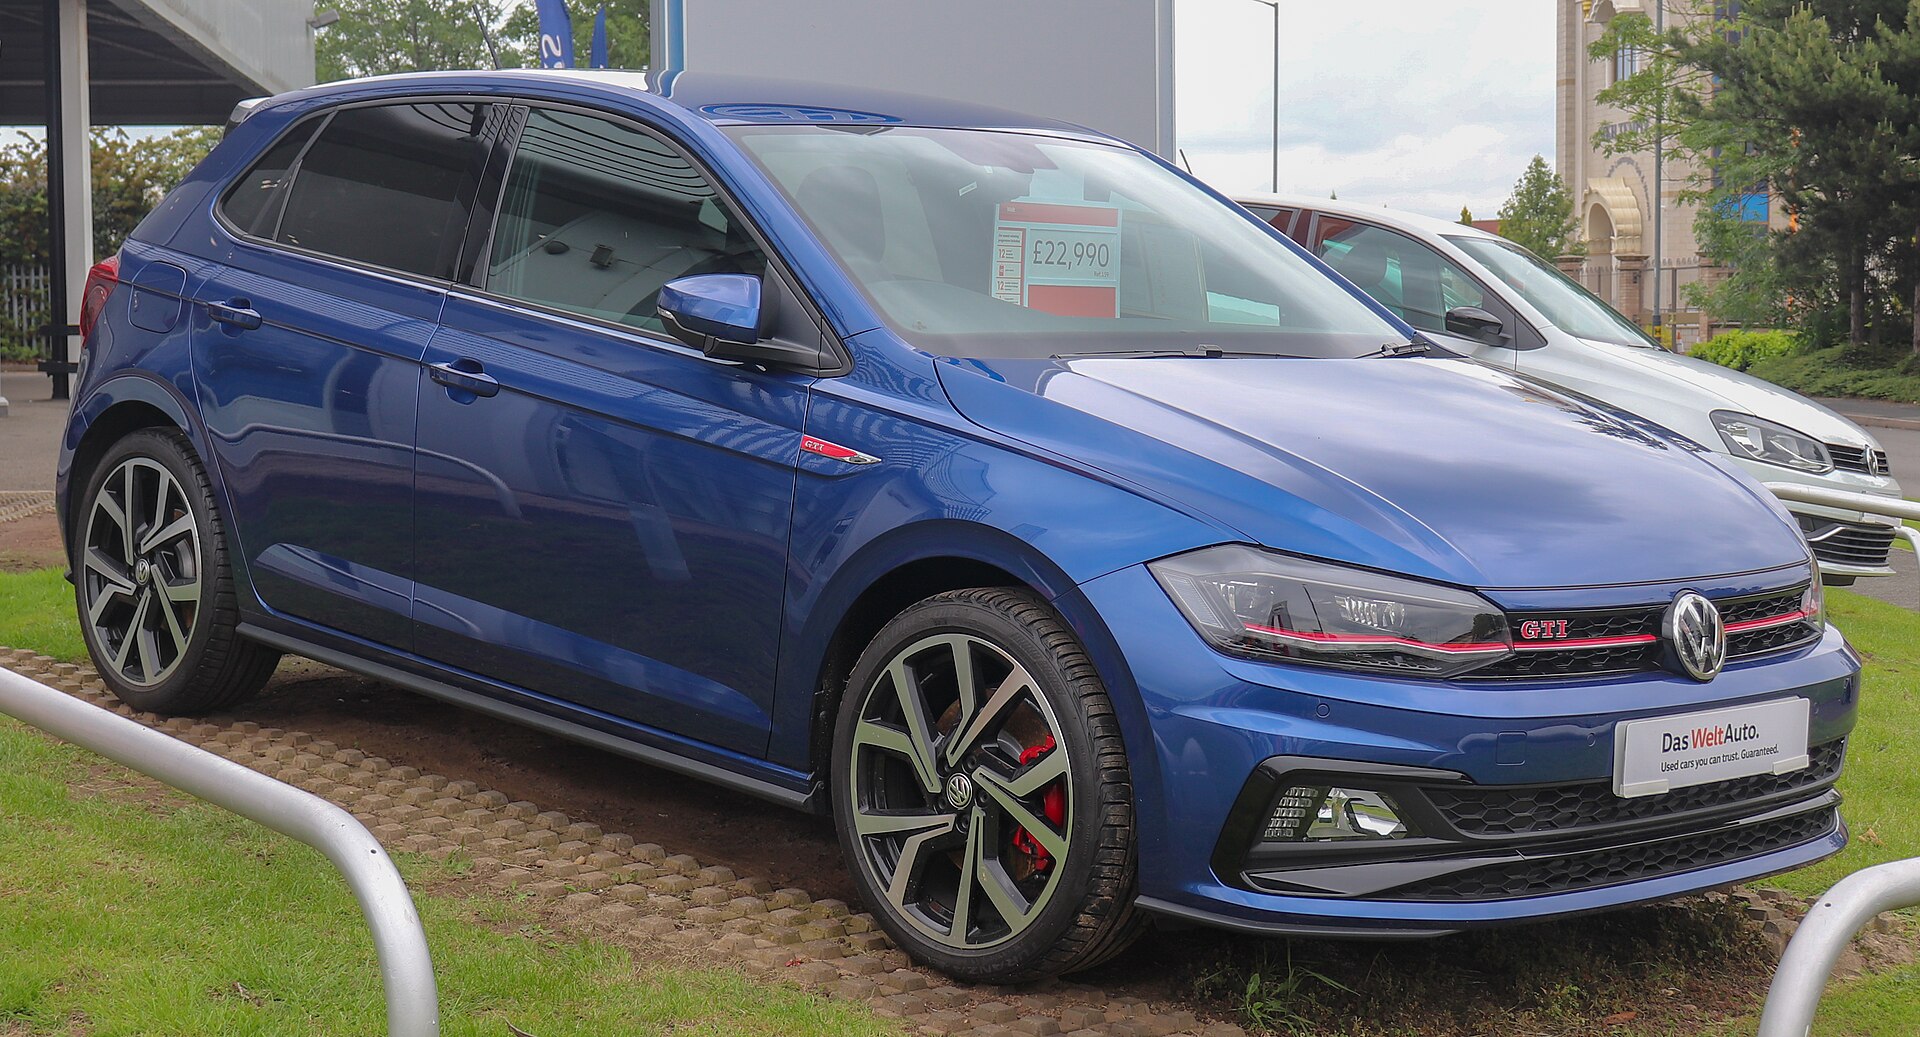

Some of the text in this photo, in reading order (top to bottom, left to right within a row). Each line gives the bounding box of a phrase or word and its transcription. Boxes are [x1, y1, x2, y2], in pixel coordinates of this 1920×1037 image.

[1033, 239, 1109, 270] £22,990
[804, 440, 824, 451] GTI
[1520, 619, 1568, 639] GTI
[1661, 732, 1688, 754] Das
[1660, 744, 1779, 772] Used cars you can trust. Guaranteed.
